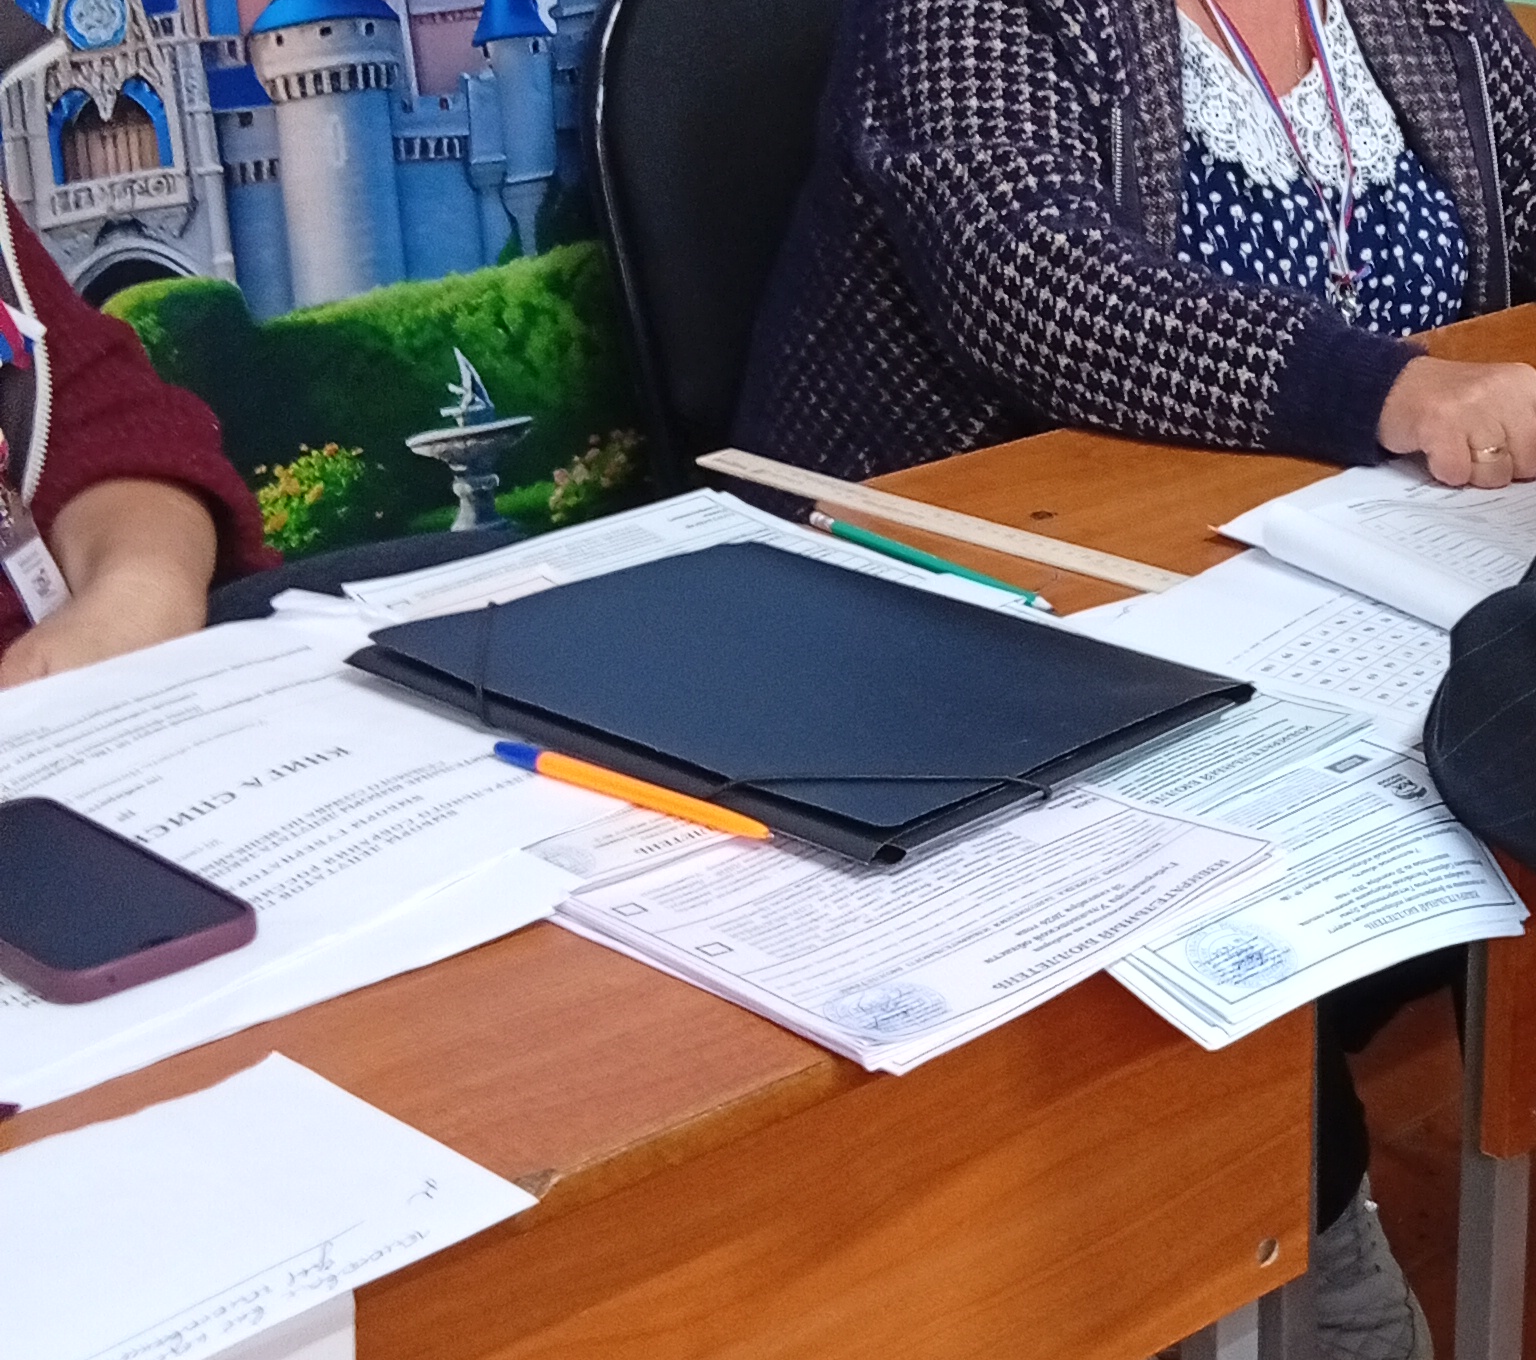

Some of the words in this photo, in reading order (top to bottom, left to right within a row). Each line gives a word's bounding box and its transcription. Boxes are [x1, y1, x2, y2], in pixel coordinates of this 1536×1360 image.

[243, 748, 348, 786] КНИГА
[1099, 860, 1228, 939] ИЗБИРАТЕЛЬНЫЙ
[993, 938, 1097, 989] БЮЛЛЕТЕНЬ
